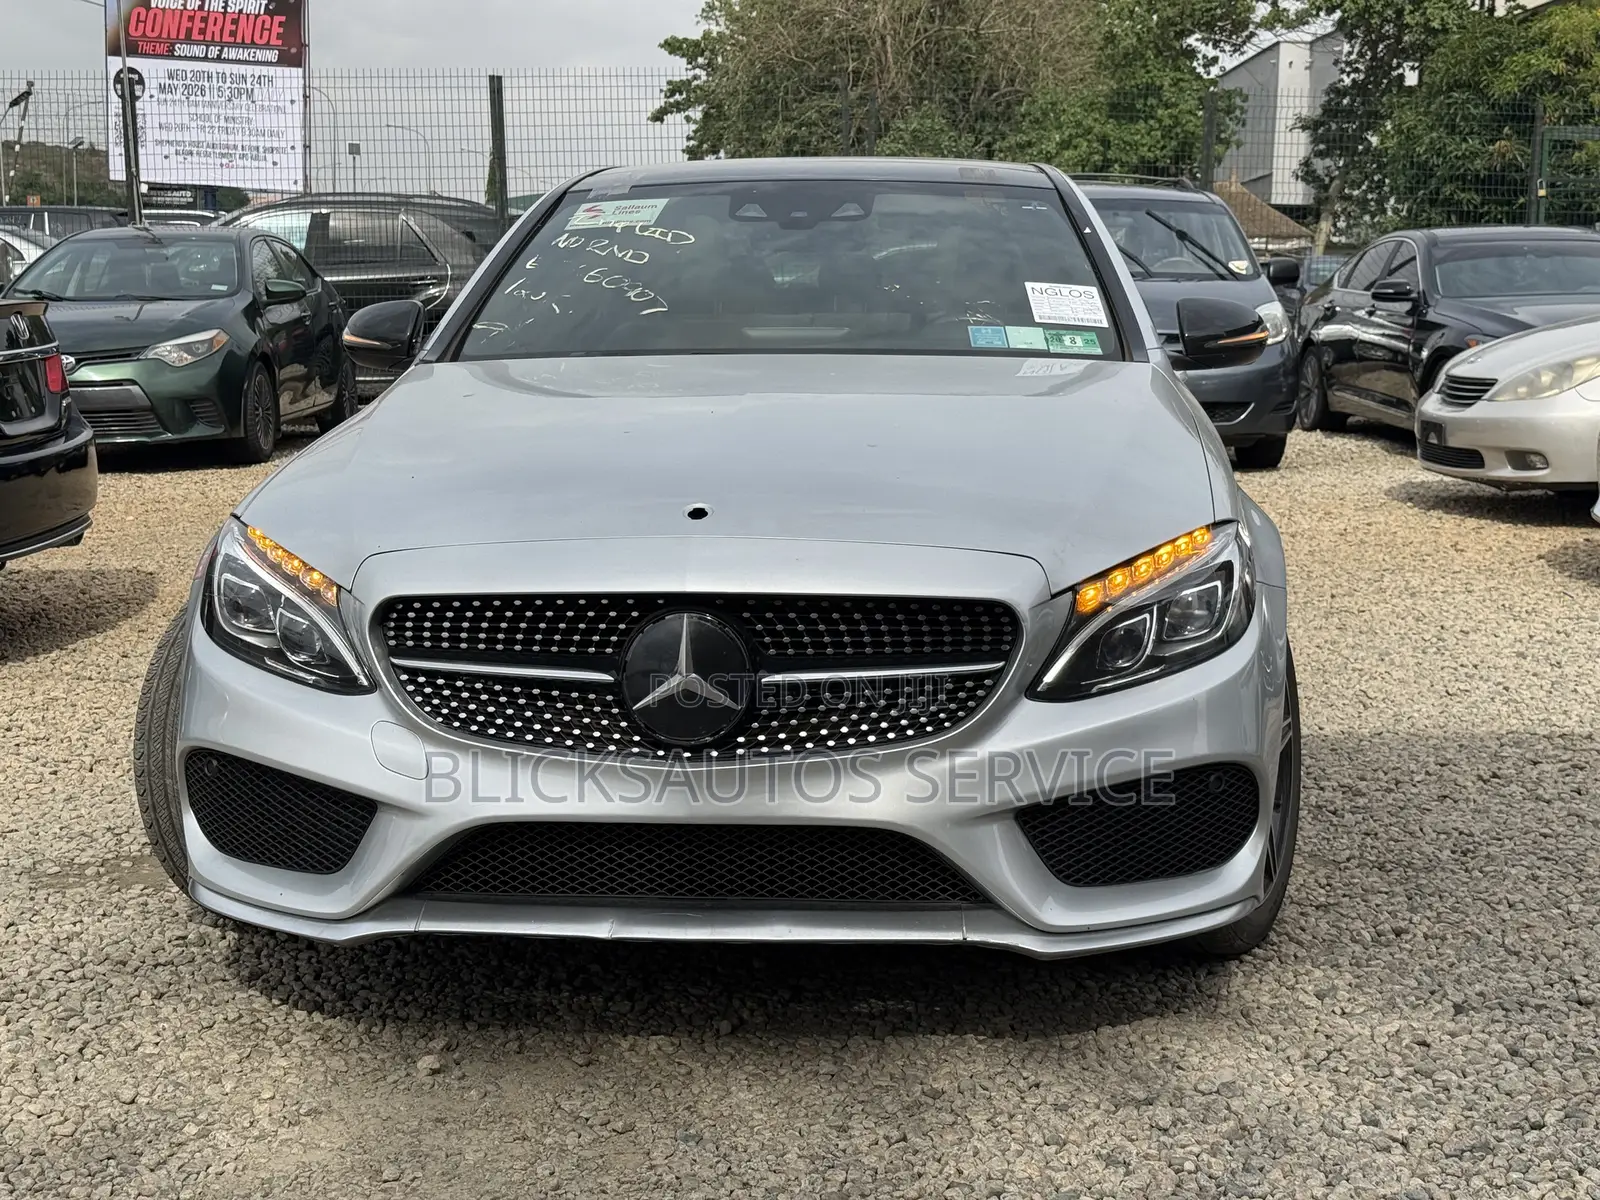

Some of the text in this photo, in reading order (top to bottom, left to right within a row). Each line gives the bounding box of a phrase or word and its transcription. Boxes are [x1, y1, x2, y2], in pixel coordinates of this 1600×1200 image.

[150, 0, 268, 14] VOICE OF THE SPIRIT
[128, 7, 286, 46] CONFERENCE
[137, 41, 279, 63] THEME: SOUND OF AWAKENING
[167, 68, 274, 87] WED 20TH TO SUN 24TH
[158, 82, 180, 96] MAY
[181, 83, 206, 97] 2026
[217, 86, 255, 101] 5:30PM
[1031, 287, 1095, 300] NGLOS
[1069, 337, 1077, 345] 8
